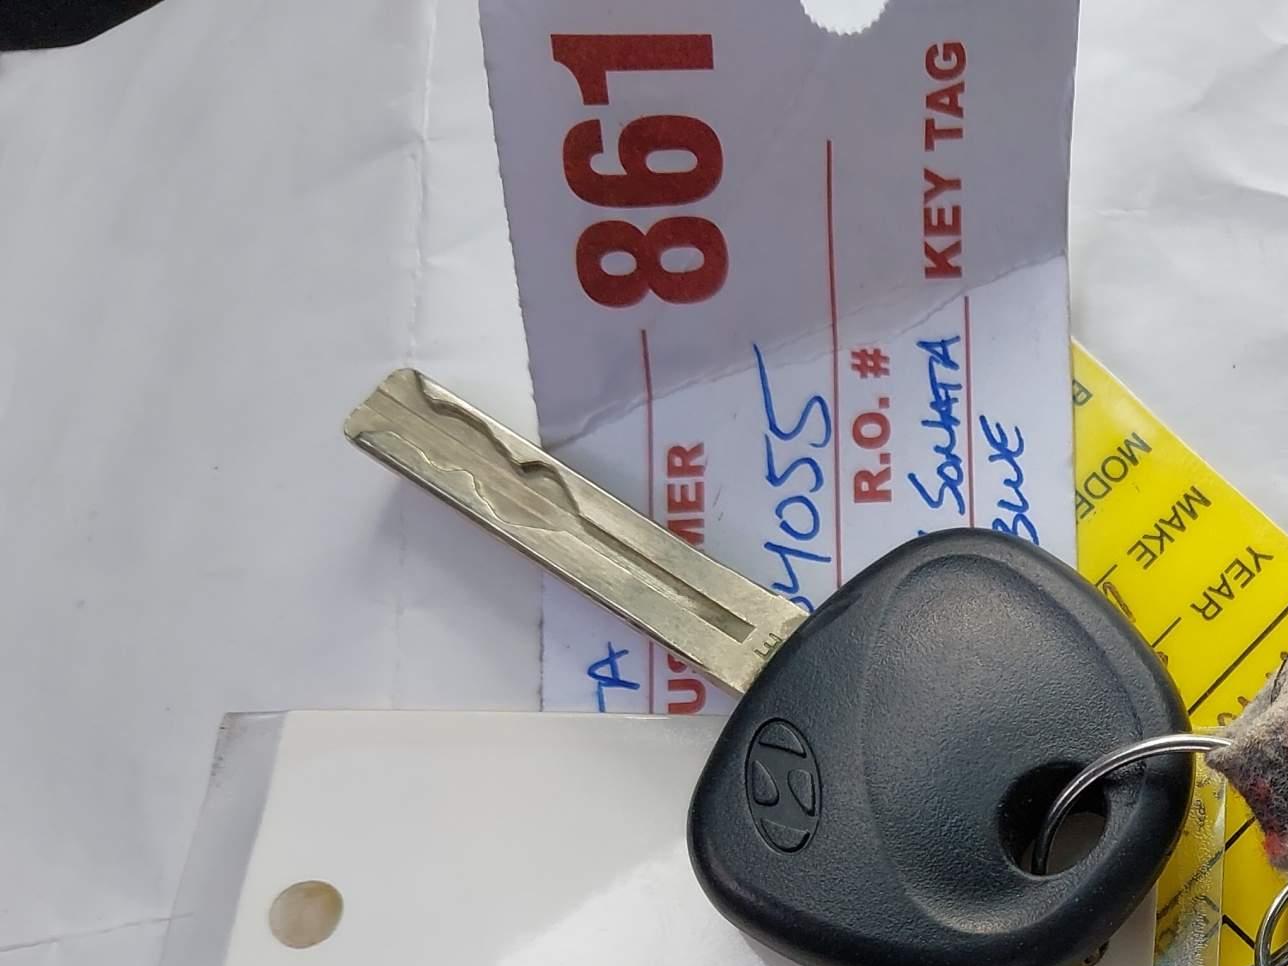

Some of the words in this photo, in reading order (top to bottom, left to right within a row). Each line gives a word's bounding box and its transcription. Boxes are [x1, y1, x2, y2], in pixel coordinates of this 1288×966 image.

[924, 41, 967, 152] TAG
[550, 34, 728, 308] 861
[923, 167, 963, 279] KEY
[851, 348, 890, 378] #
[852, 396, 892, 503] R.O.
[1127, 486, 1213, 570] MAKE
[1190, 545, 1275, 622] YEAR
